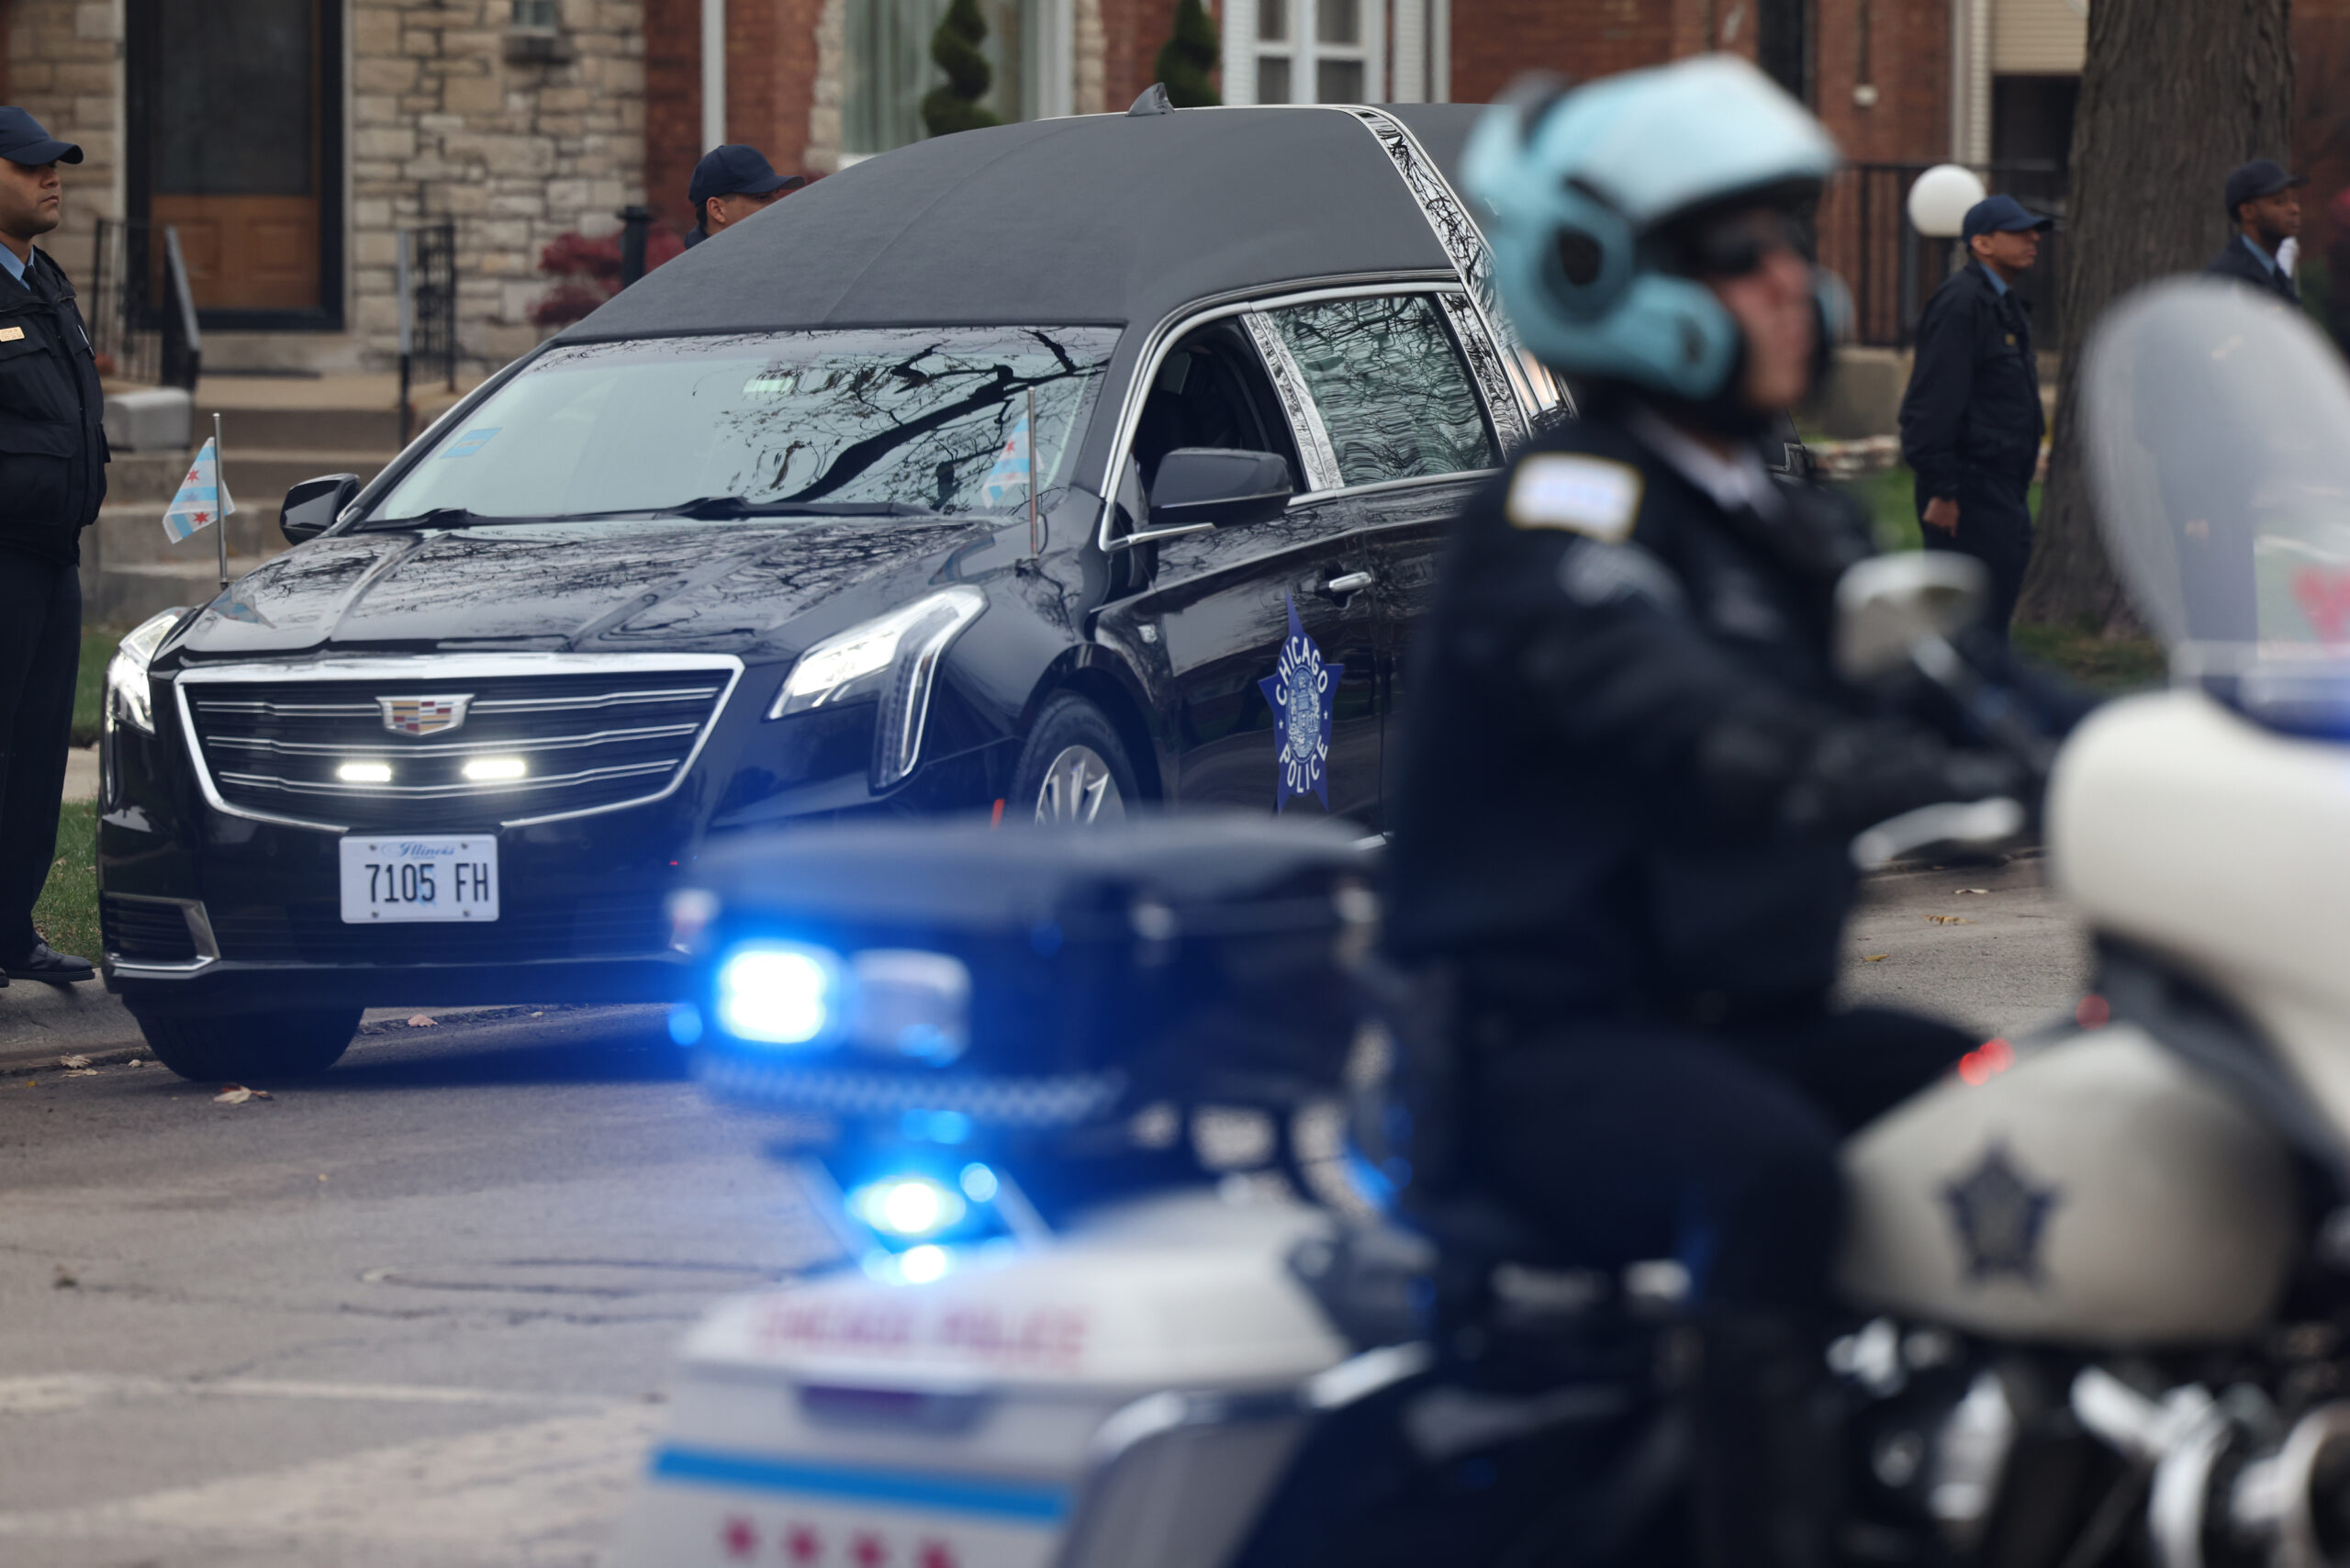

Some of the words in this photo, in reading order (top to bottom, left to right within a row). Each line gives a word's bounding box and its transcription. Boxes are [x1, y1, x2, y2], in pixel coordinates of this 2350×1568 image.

[1275, 635, 1329, 706] CHICAGO
[1279, 734, 1328, 794] POLICE
[384, 842, 455, 857] Illinois
[364, 863, 436, 903] 7105
[454, 862, 489, 902] FH
